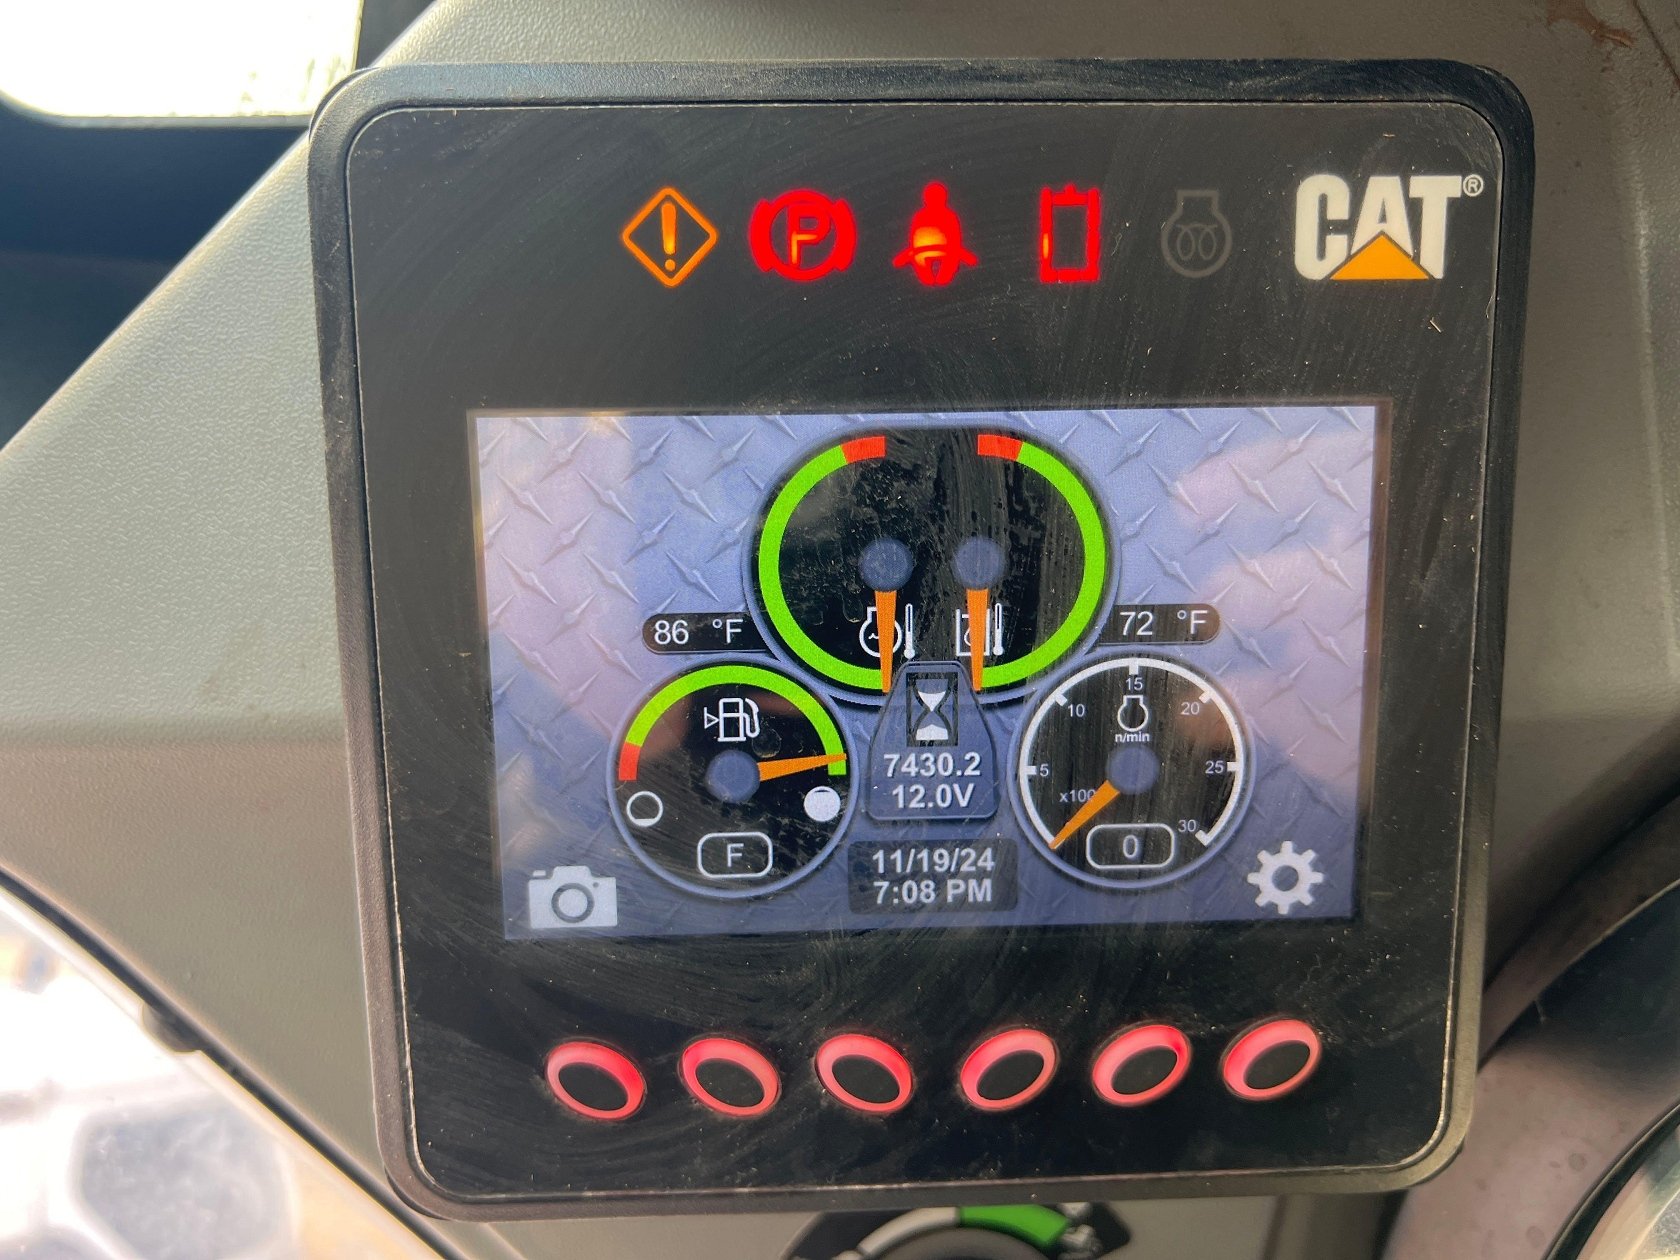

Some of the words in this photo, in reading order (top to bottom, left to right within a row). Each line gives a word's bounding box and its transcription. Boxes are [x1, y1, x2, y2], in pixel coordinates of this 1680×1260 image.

[653, 619, 690, 645] 86
[711, 617, 744, 644] °F
[1119, 611, 1154, 636] 72
[1176, 609, 1208, 635] °F
[1125, 677, 1143, 691] 15
[1067, 704, 1085, 718] 10
[1181, 702, 1200, 716] 20
[1114, 731, 1151, 743] n/min
[883, 751, 981, 777] 7430.2
[1039, 763, 1049, 777] 5
[1205, 761, 1225, 775] 25
[893, 784, 975, 809] 12.0V
[1178, 819, 1197, 833] 30
[727, 843, 744, 867] F
[1122, 834, 1139, 858] 0
[872, 847, 995, 873] 11/19/24
[874, 881, 936, 904] 7:08
[946, 878, 993, 902] PM
